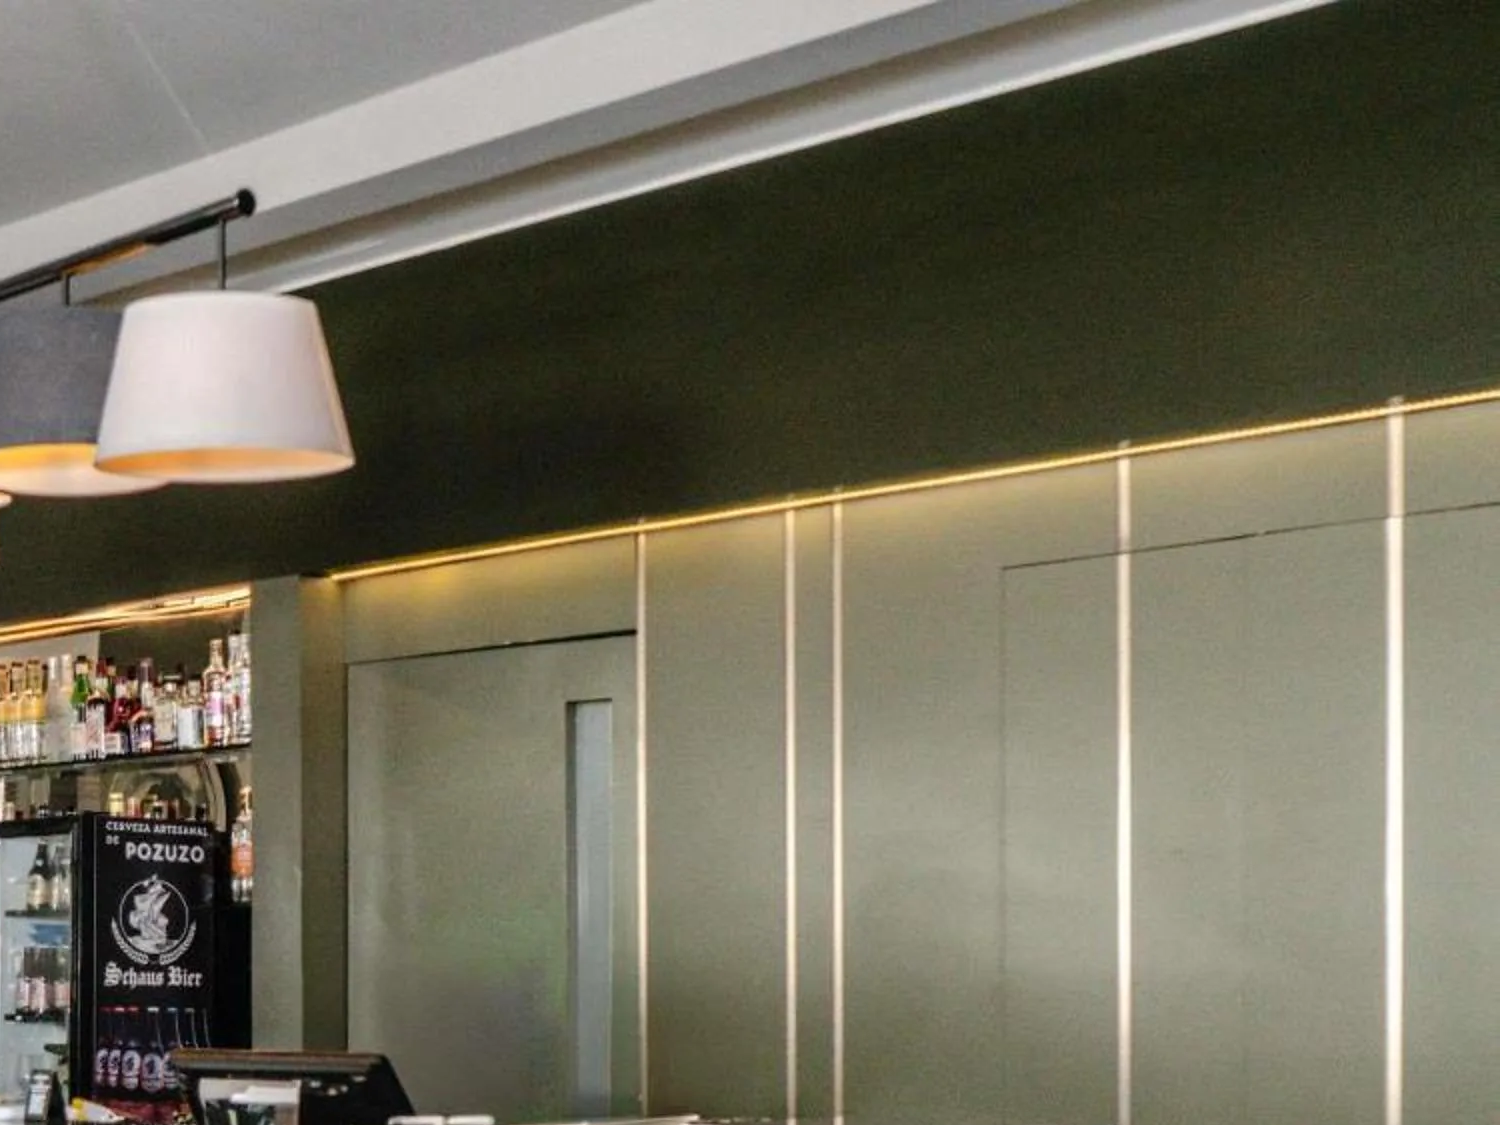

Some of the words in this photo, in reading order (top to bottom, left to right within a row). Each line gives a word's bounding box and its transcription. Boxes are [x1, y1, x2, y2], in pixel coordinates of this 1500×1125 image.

[105, 835, 119, 845] DE
[125, 842, 205, 863] POZUZO
[167, 965, 203, 988] Bier
